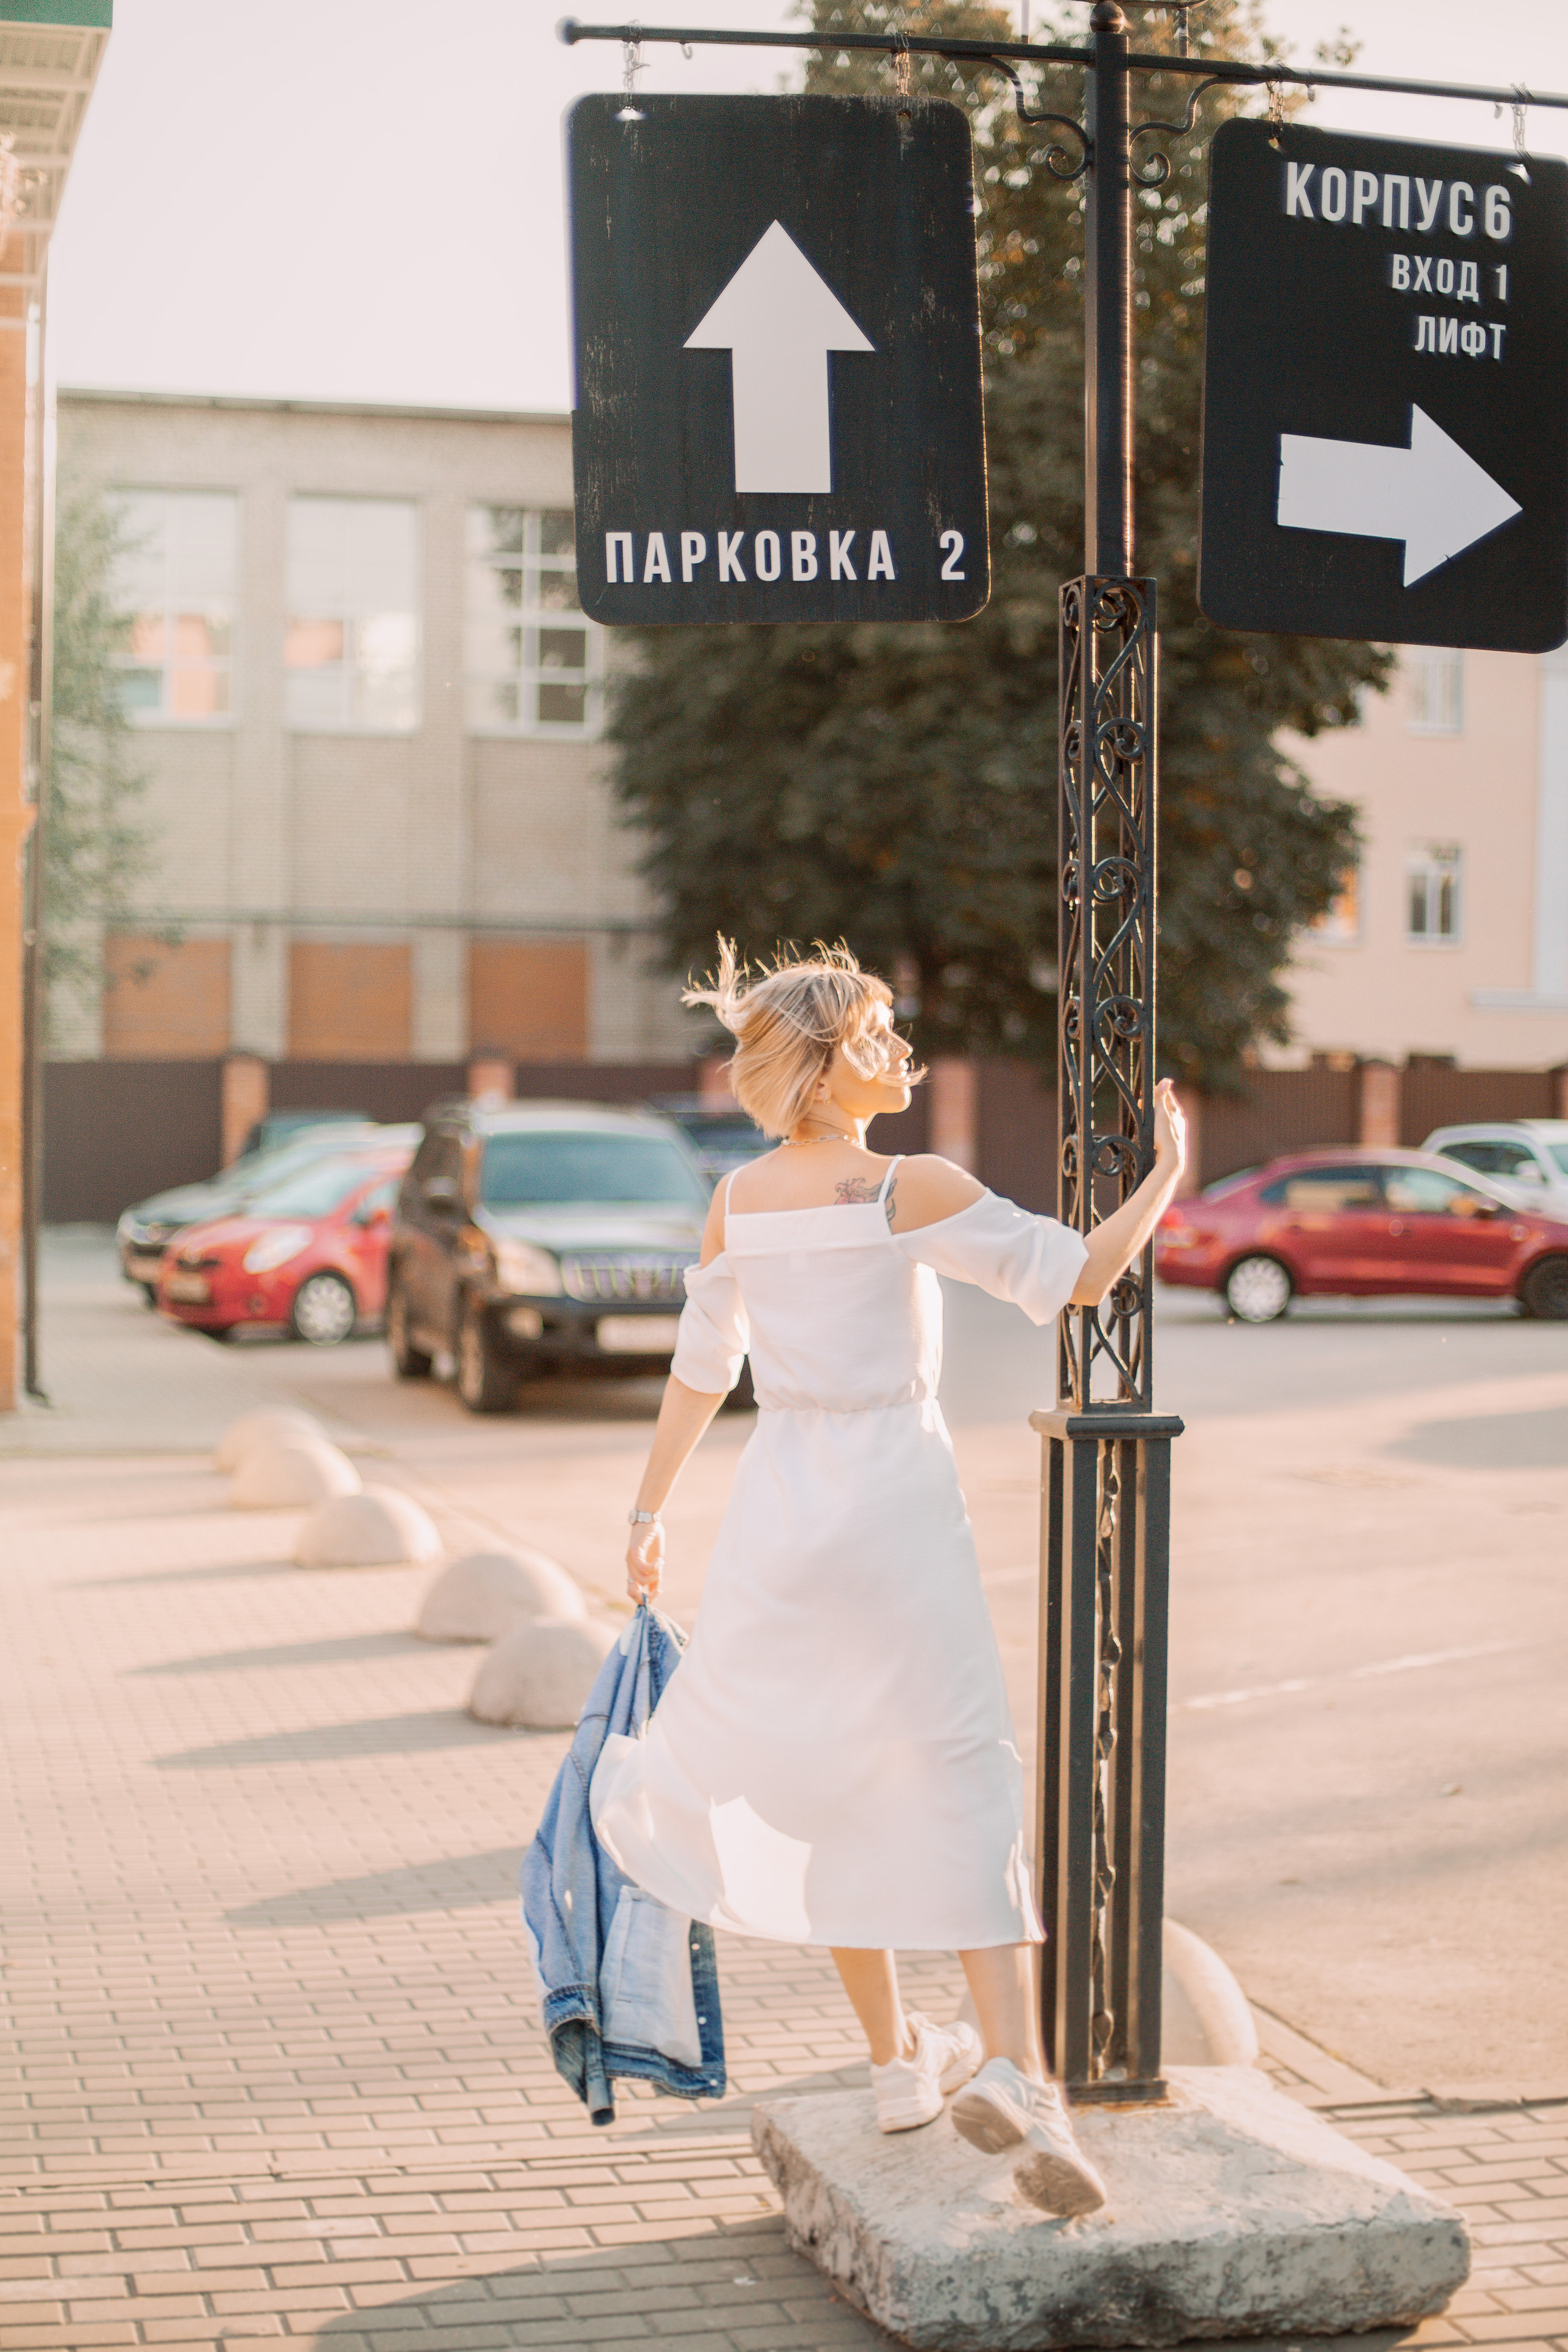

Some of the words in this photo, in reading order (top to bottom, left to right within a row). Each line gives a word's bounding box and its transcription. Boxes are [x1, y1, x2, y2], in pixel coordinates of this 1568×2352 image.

[1286, 161, 1474, 236] КОРПУС
[1391, 253, 1480, 303] ВХОД
[1494, 264, 1507, 301] 1
[1414, 315, 1507, 360] ЛИФТ
[605, 529, 896, 584] ПАРКОВКА
[939, 529, 966, 581] 2
